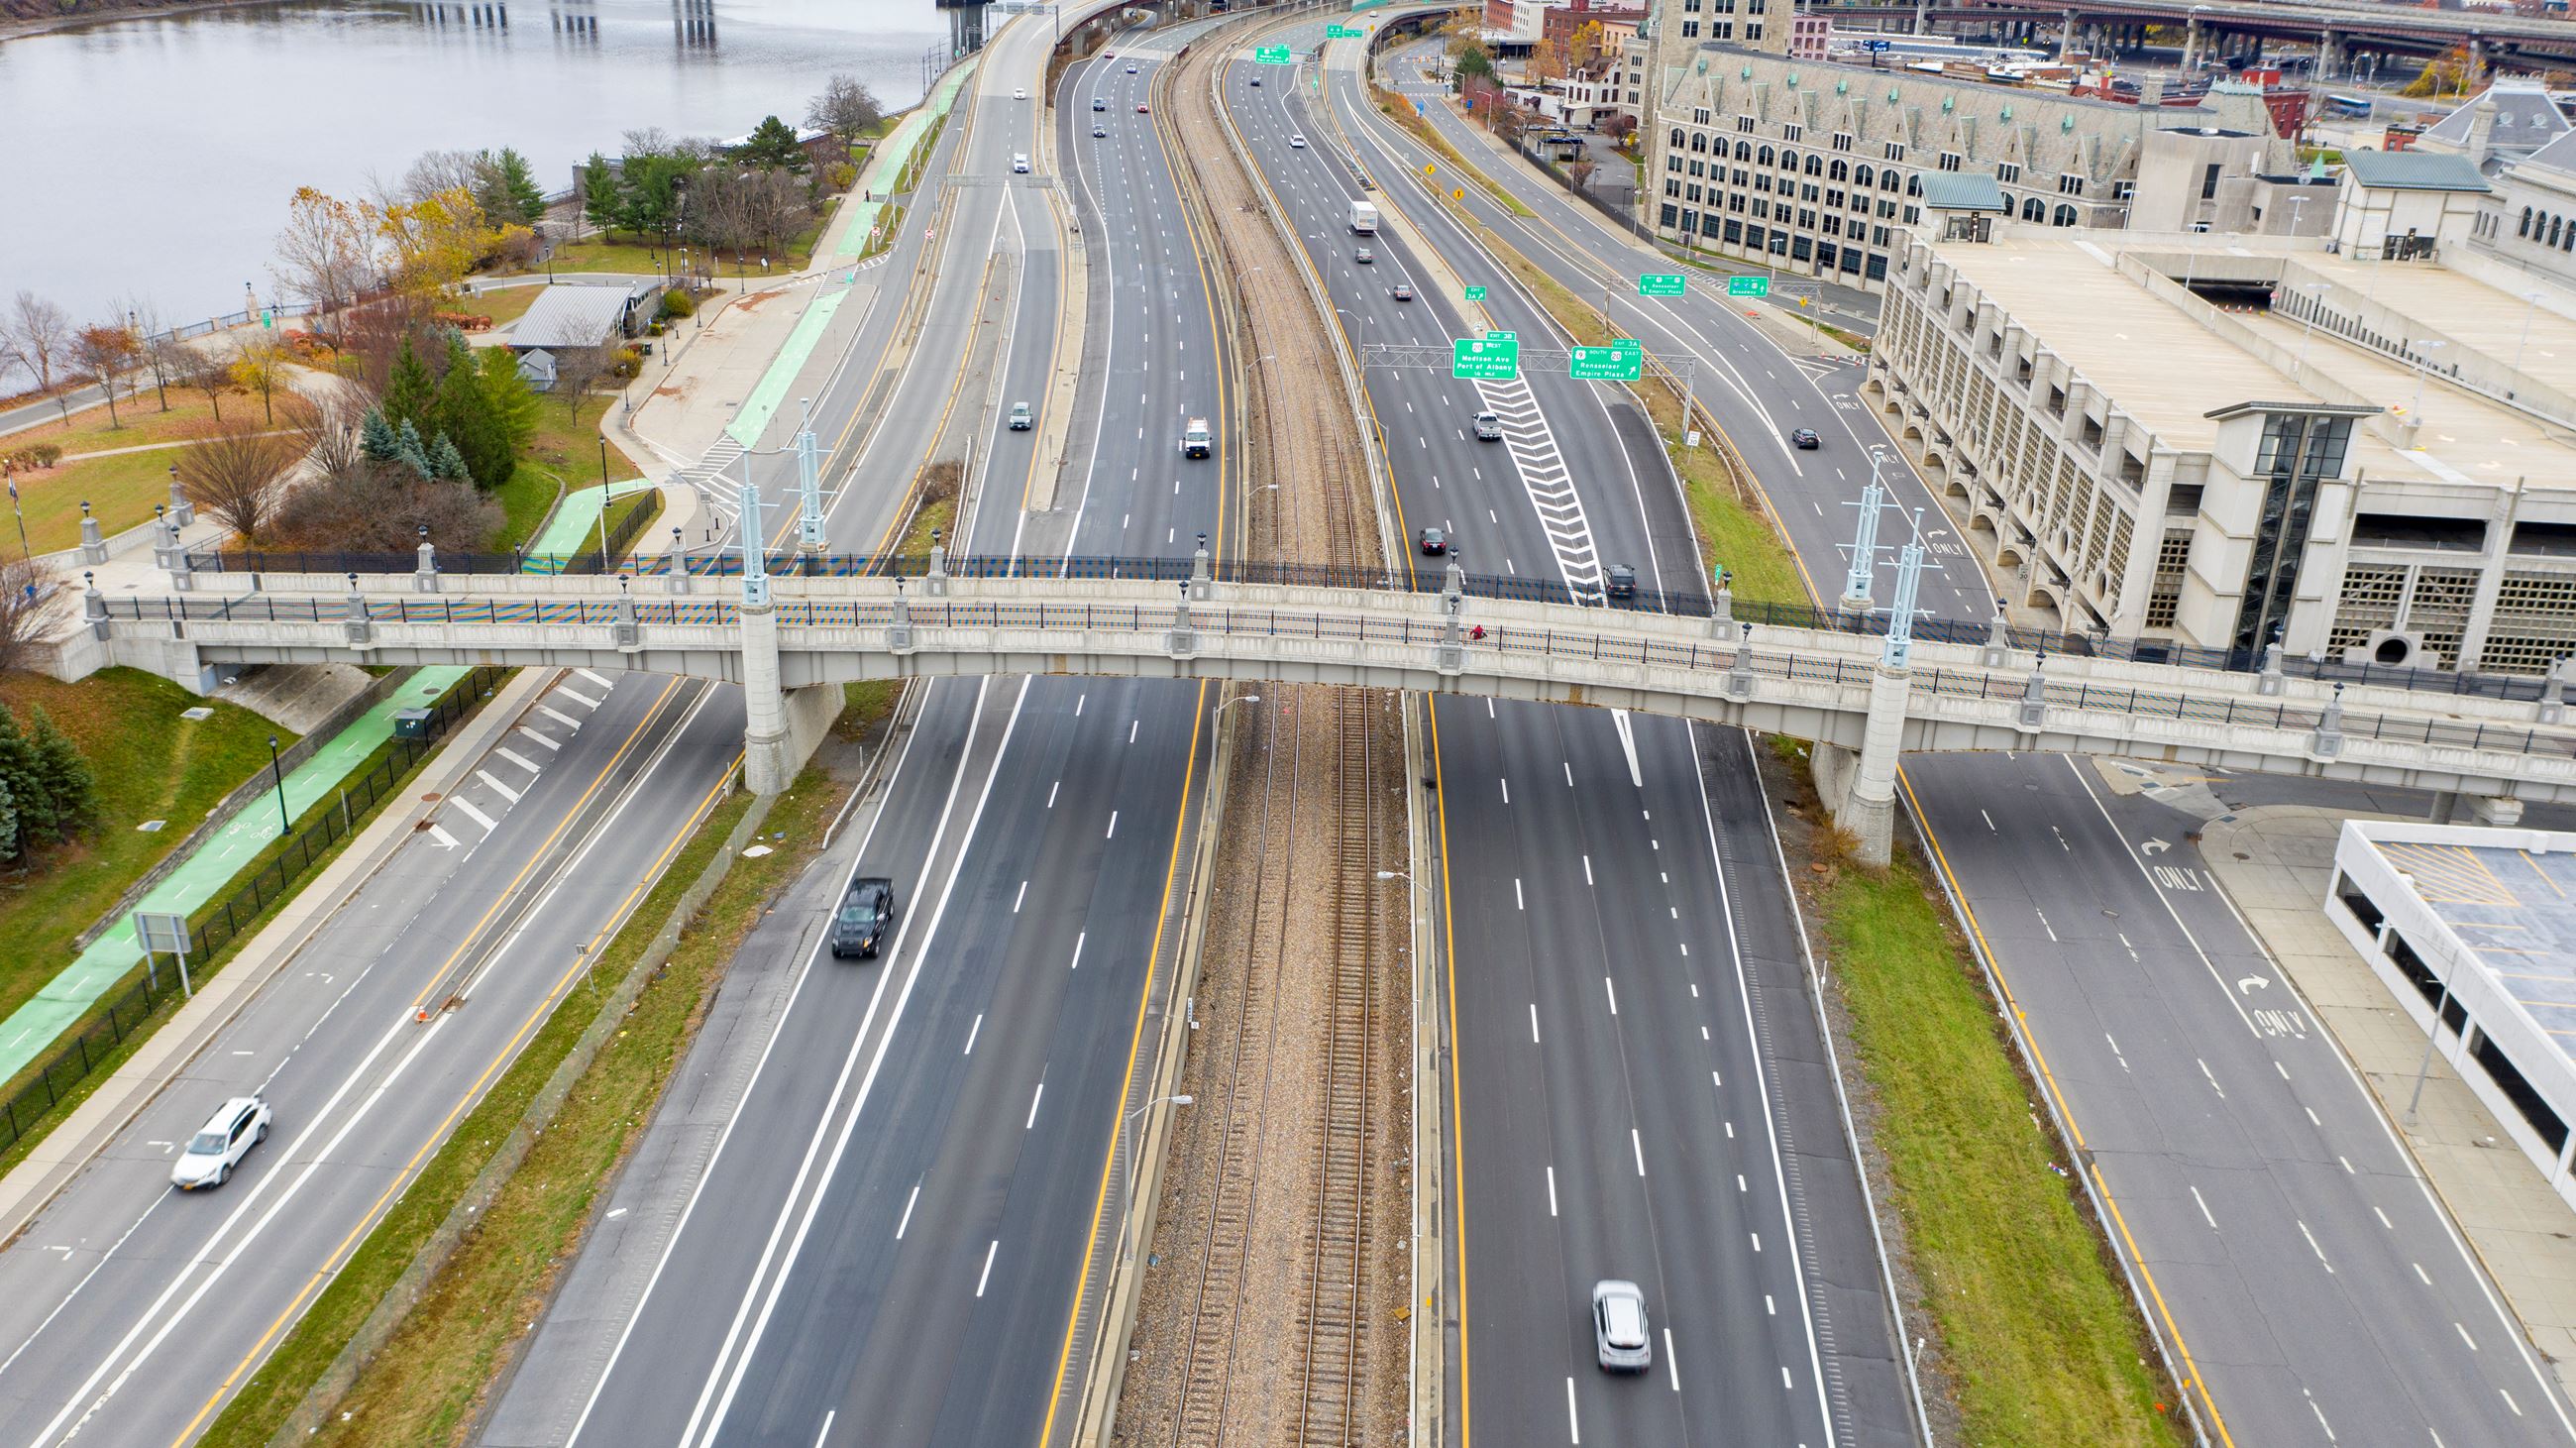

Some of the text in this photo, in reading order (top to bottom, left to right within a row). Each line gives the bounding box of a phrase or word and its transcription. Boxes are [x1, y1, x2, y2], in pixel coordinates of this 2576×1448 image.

[1836, 401, 1861, 410] ONLY
[1932, 543, 1964, 555] ONLY
[2153, 865, 2204, 891] ONLY
[2253, 1008, 2308, 1040] ONLY
